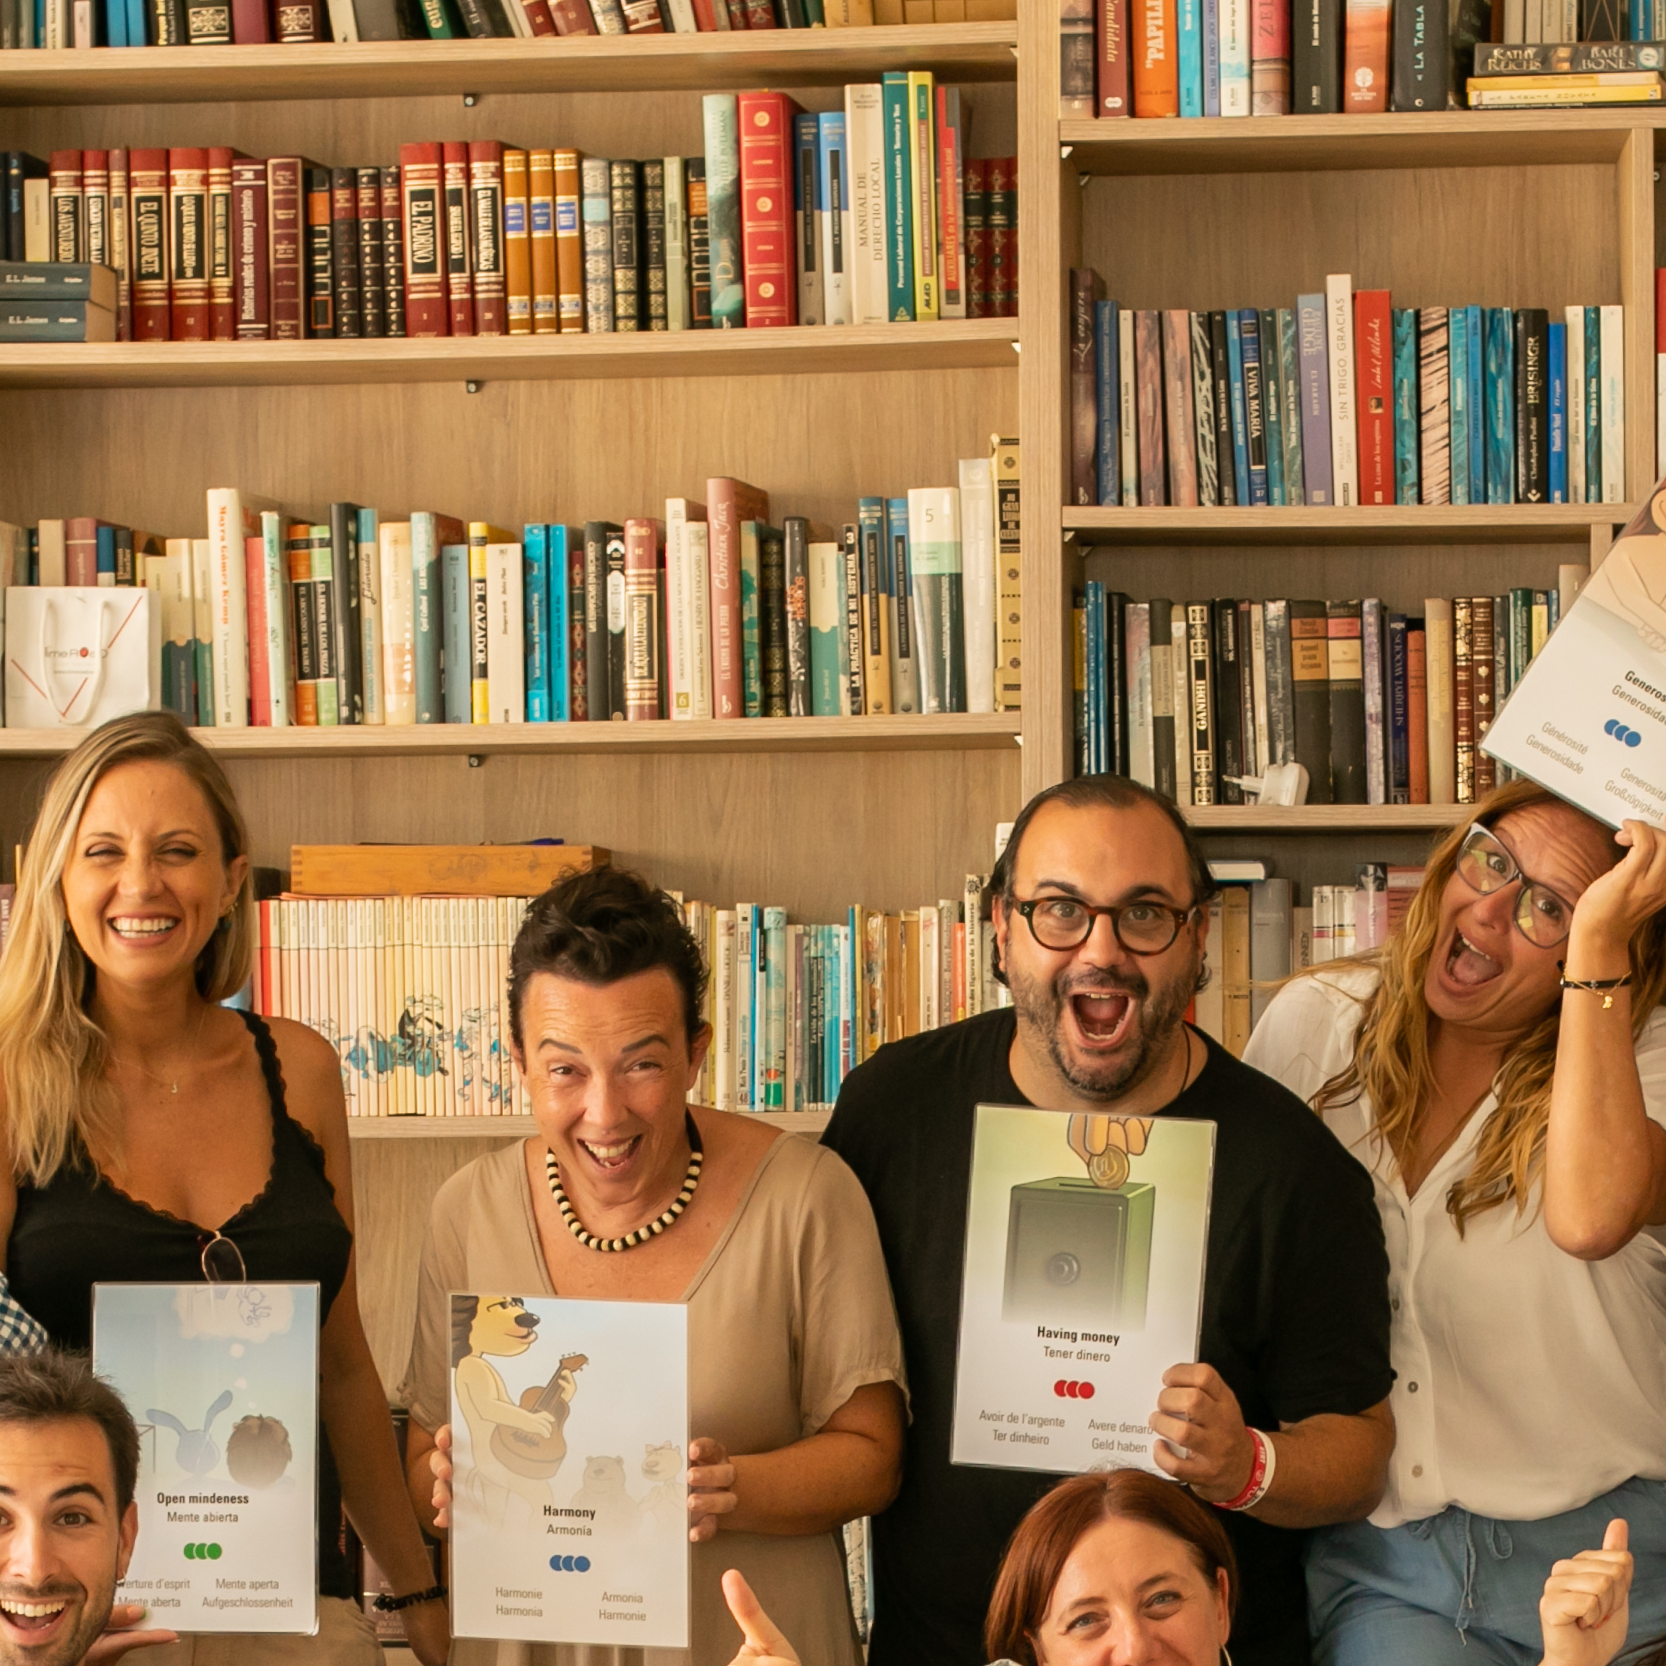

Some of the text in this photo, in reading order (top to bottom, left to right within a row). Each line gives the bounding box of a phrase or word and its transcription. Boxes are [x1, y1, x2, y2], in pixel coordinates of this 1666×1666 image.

[1414, 5, 1425, 69] LA TABLA
[856, 172, 869, 248] MANUAL DE
[870, 158, 884, 262] DERECHO LOCAL
[411, 200, 435, 264] EL PADRINO
[1302, 307, 1316, 357] GEDGE
[1335, 298, 1347, 351] GRACIAS
[1526, 336, 1540, 404] BRISINGR
[1247, 369, 1262, 439] VIVA MARÍA
[1338, 402, 1349, 421] SIN
[219, 505, 227, 543] Mayra
[925, 508, 934, 523] 5
[714, 502, 729, 591] Christian Jacq
[847, 553, 856, 602] SISTEMA
[221, 589, 229, 625] Kemp
[474, 582, 487, 666] EL CAZADOR
[1196, 680, 1207, 730] GANDHI
[1541, 720, 1588, 756] Générosité
[1525, 734, 1584, 775] Generosidade
[1604, 780, 1665, 821] Großzügigkeit
[1037, 1325, 1121, 1347] Having money
[1043, 1345, 1111, 1363] Tener dinero
[978, 1409, 1005, 1423] Avoir
[1006, 1412, 1020, 1425] de
[1088, 1418, 1154, 1436] Avere denaro
[993, 1429, 1050, 1446] Ter dinheiro
[1091, 1437, 1148, 1454] Geld haben
[156, 1491, 250, 1507] Open mindeness
[167, 1511, 239, 1523] Mente abierta
[543, 1504, 596, 1521] Harmony
[546, 1523, 593, 1537] Armonía
[215, 1578, 280, 1591] Mente aperta
[495, 1586, 543, 1600] Harmonie
[151, 1597, 181, 1608] aberta
[201, 1597, 294, 1610] Aufgeschlossenheit
[601, 1591, 644, 1604] Armonia
[495, 1604, 543, 1618] Harmonia
[598, 1608, 647, 1622] Harmonie
